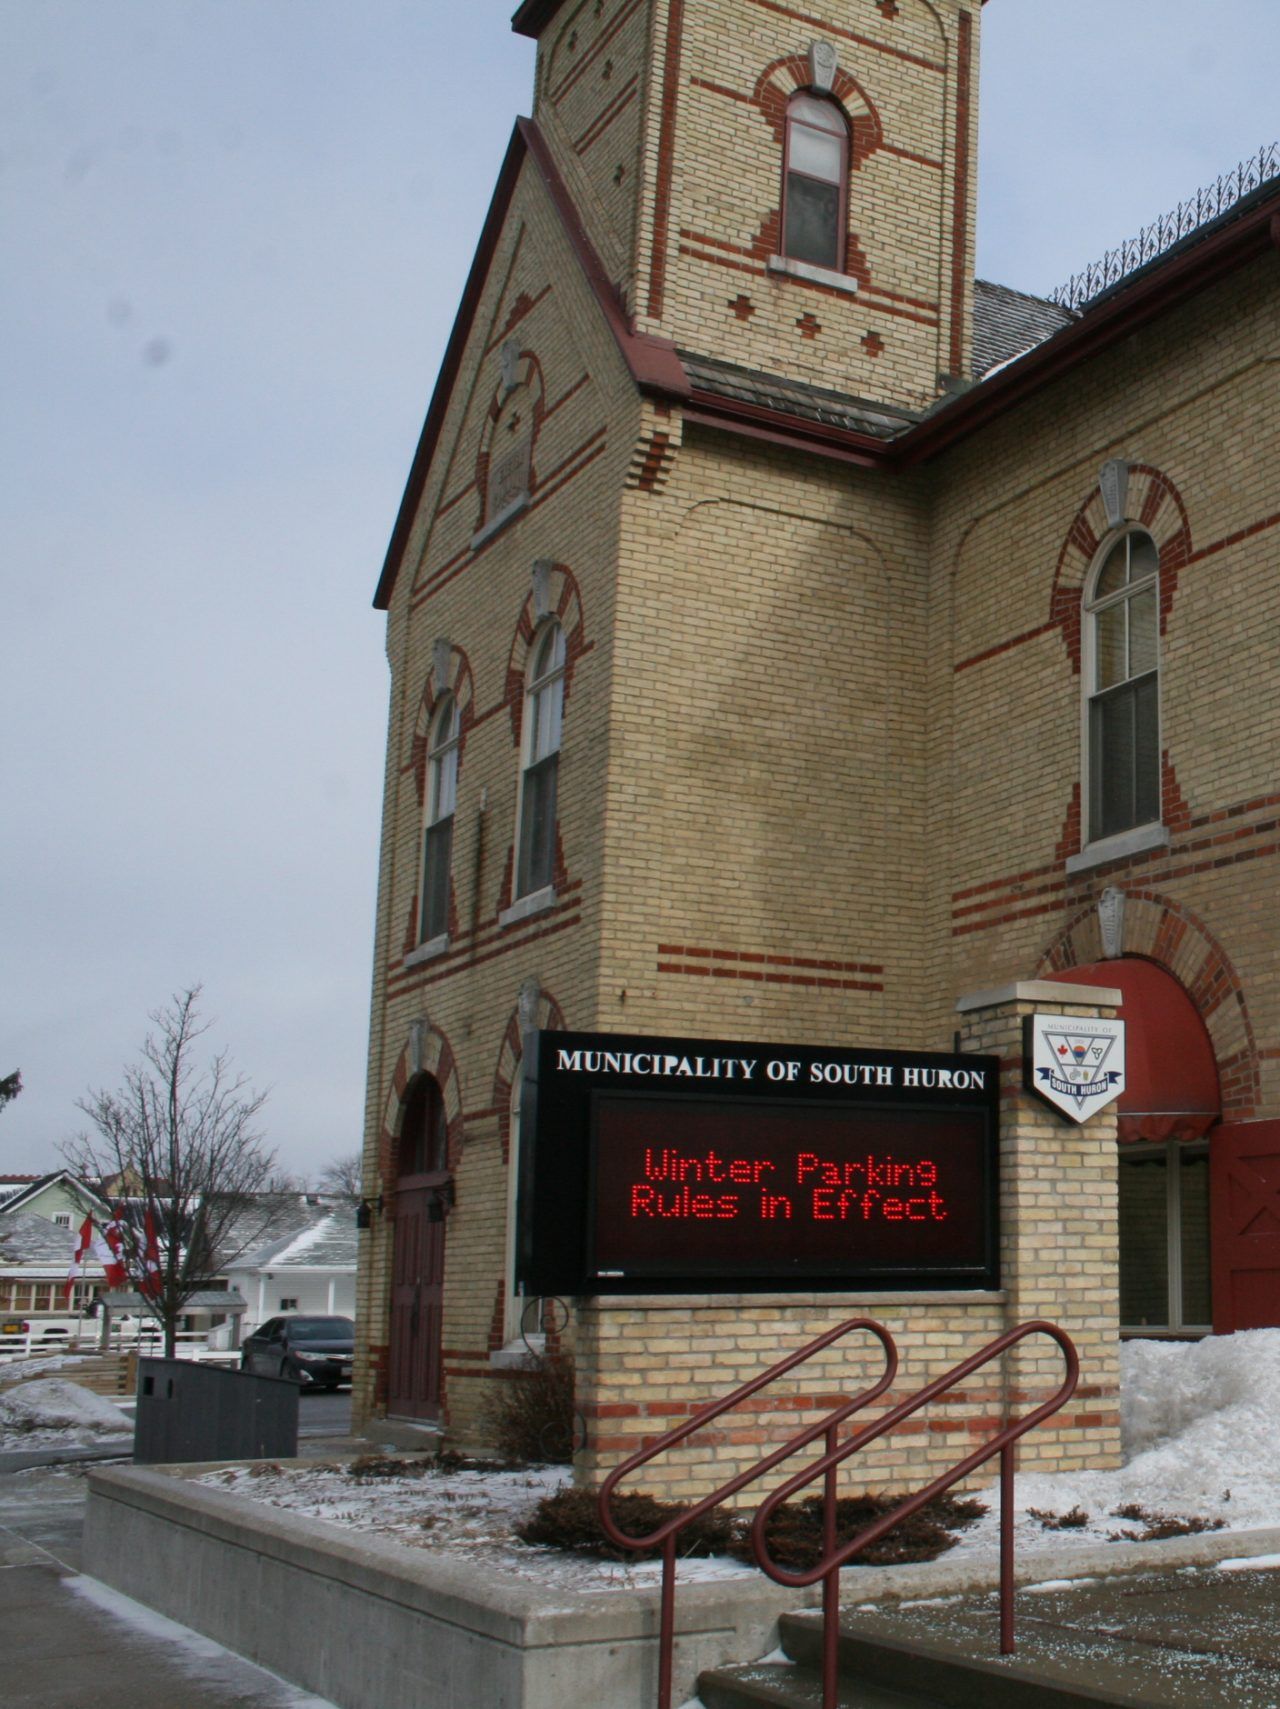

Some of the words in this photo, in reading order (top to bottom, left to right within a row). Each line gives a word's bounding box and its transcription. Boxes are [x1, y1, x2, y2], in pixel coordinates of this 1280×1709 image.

[1047, 1023, 1098, 1032] MUNICIPALITY
[1102, 1026, 1112, 1034] OF
[557, 1049, 757, 1079] MUNICIPALITY
[766, 1060, 801, 1081] OF
[810, 1062, 893, 1086] SOUTH
[902, 1067, 985, 1089] HURON
[1051, 1077, 1078, 1095] SOUTH
[1080, 1078, 1107, 1095] HURON
[645, 1148, 776, 1183] Winter
[798, 1153, 937, 1187] Parking
[631, 1185, 740, 1218] Rules
[761, 1187, 792, 1219] in
[813, 1188, 948, 1220] Effect
